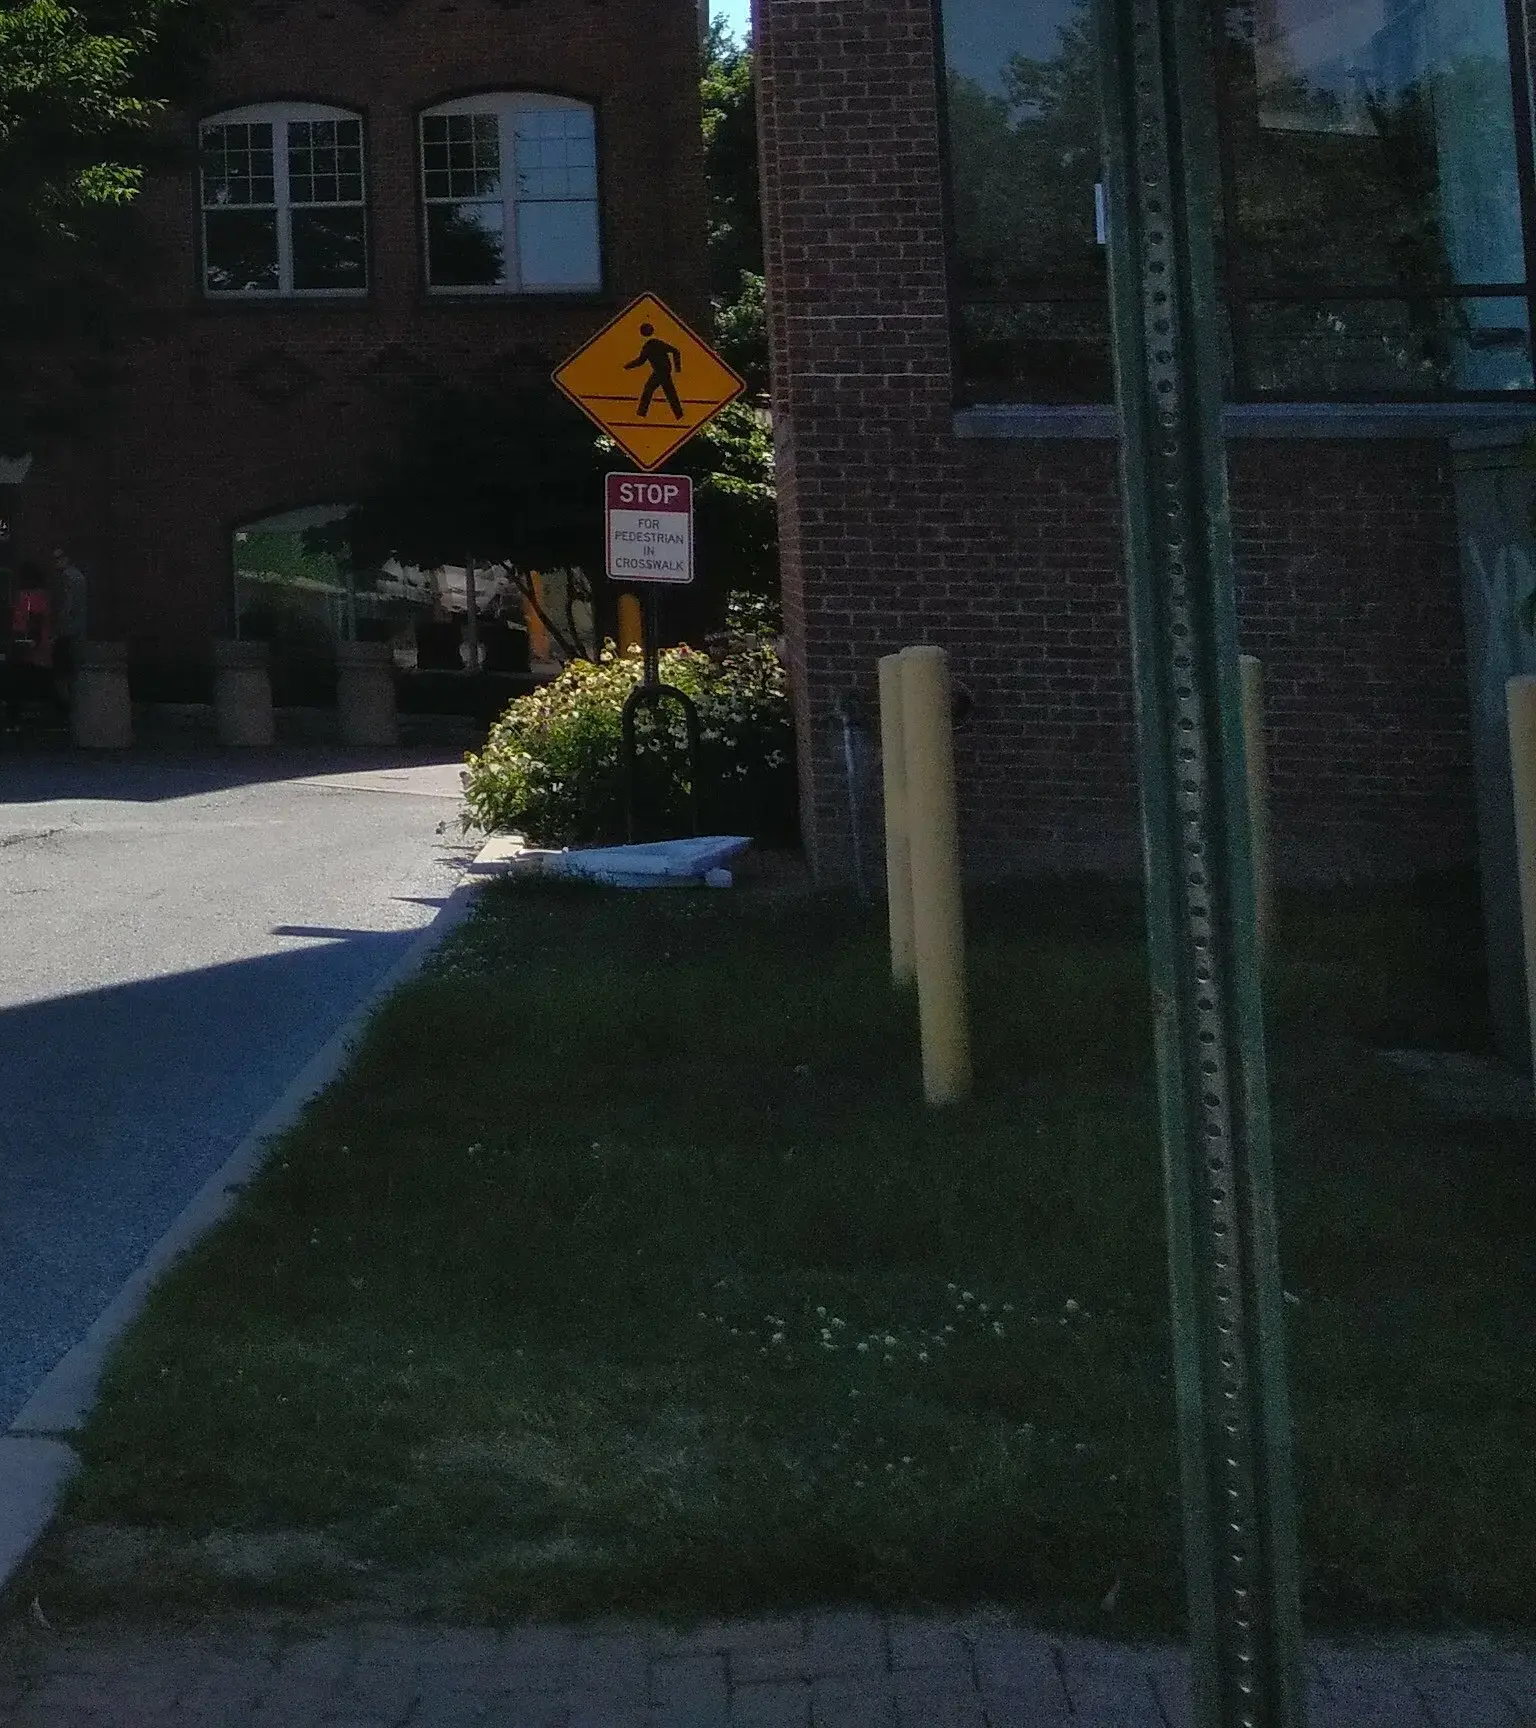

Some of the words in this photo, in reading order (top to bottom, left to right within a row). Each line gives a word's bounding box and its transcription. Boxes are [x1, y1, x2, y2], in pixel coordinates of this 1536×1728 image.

[619, 482, 679, 504] STOP
[637, 518, 660, 530] FOR
[614, 531, 685, 545] PEDESTRIAN
[643, 545, 655, 556] IN
[615, 557, 684, 571] CROSSWALK
